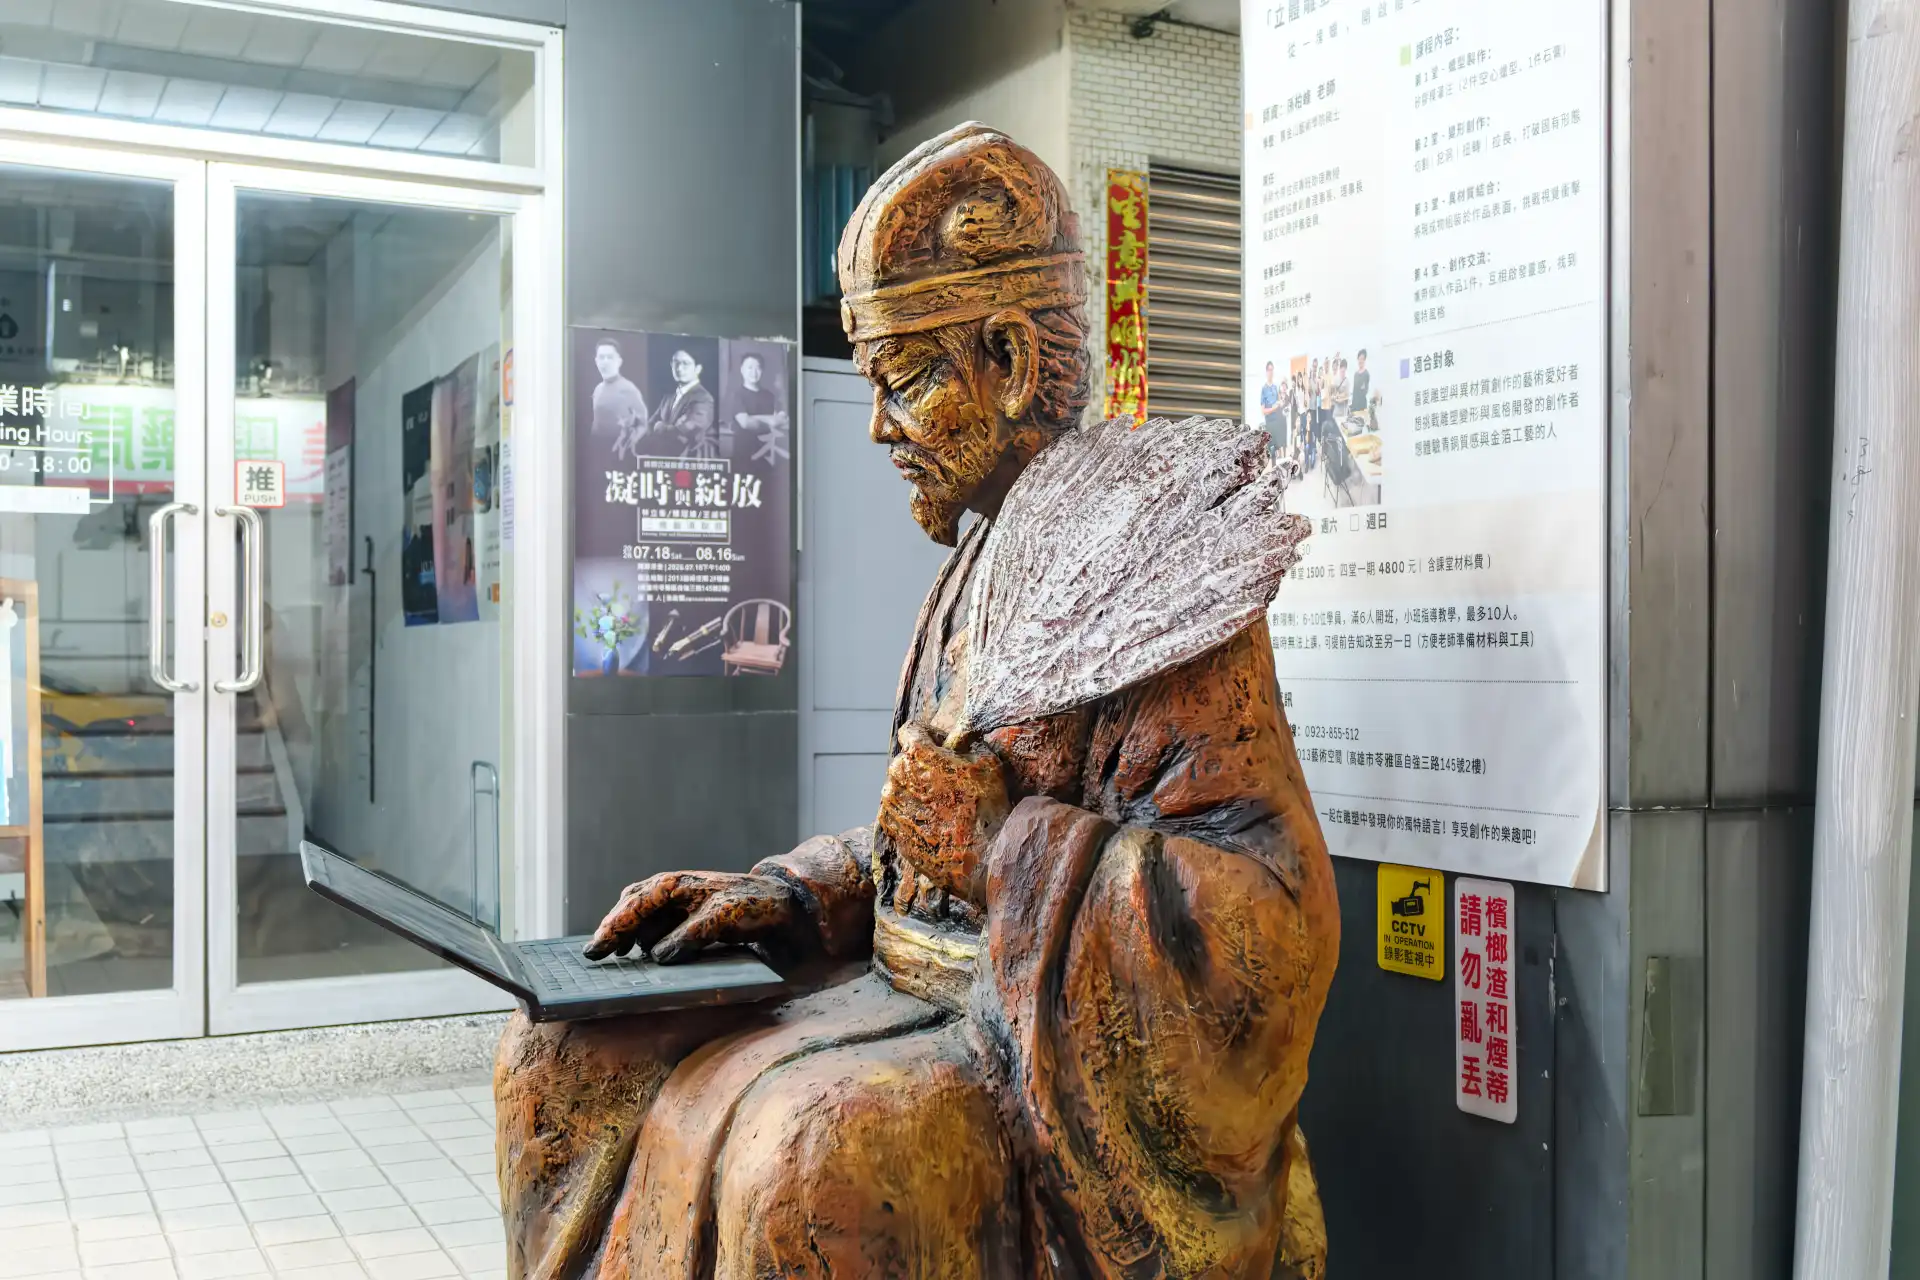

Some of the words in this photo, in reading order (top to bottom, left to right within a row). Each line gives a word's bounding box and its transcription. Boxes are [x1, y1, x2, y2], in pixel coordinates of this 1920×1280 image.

[1414, 349, 1455, 374] 適合對象
[36, 424, 93, 444] Hours
[246, 465, 275, 491] 推
[244, 494, 277, 503] PUSH
[1320, 517, 1338, 534] 週六
[1366, 512, 1387, 530] 週日
[633, 546, 671, 560] 07.18
[696, 547, 732, 561] 08.16
[1306, 566, 1325, 579] 1500
[1340, 561, 1376, 578] 四堂一期
[1378, 561, 1405, 575] 4800
[1304, 725, 1360, 741] 0923-855-512
[1391, 920, 1426, 937] CCTV
[1384, 934, 1391, 943] IN
[1394, 935, 1435, 951] OPERATION
[1383, 945, 1435, 969] 錄影監視中
[1459, 892, 1483, 1099] 請勿亂丟
[1485, 895, 1509, 1104] 檳榔渣和煙蒂
